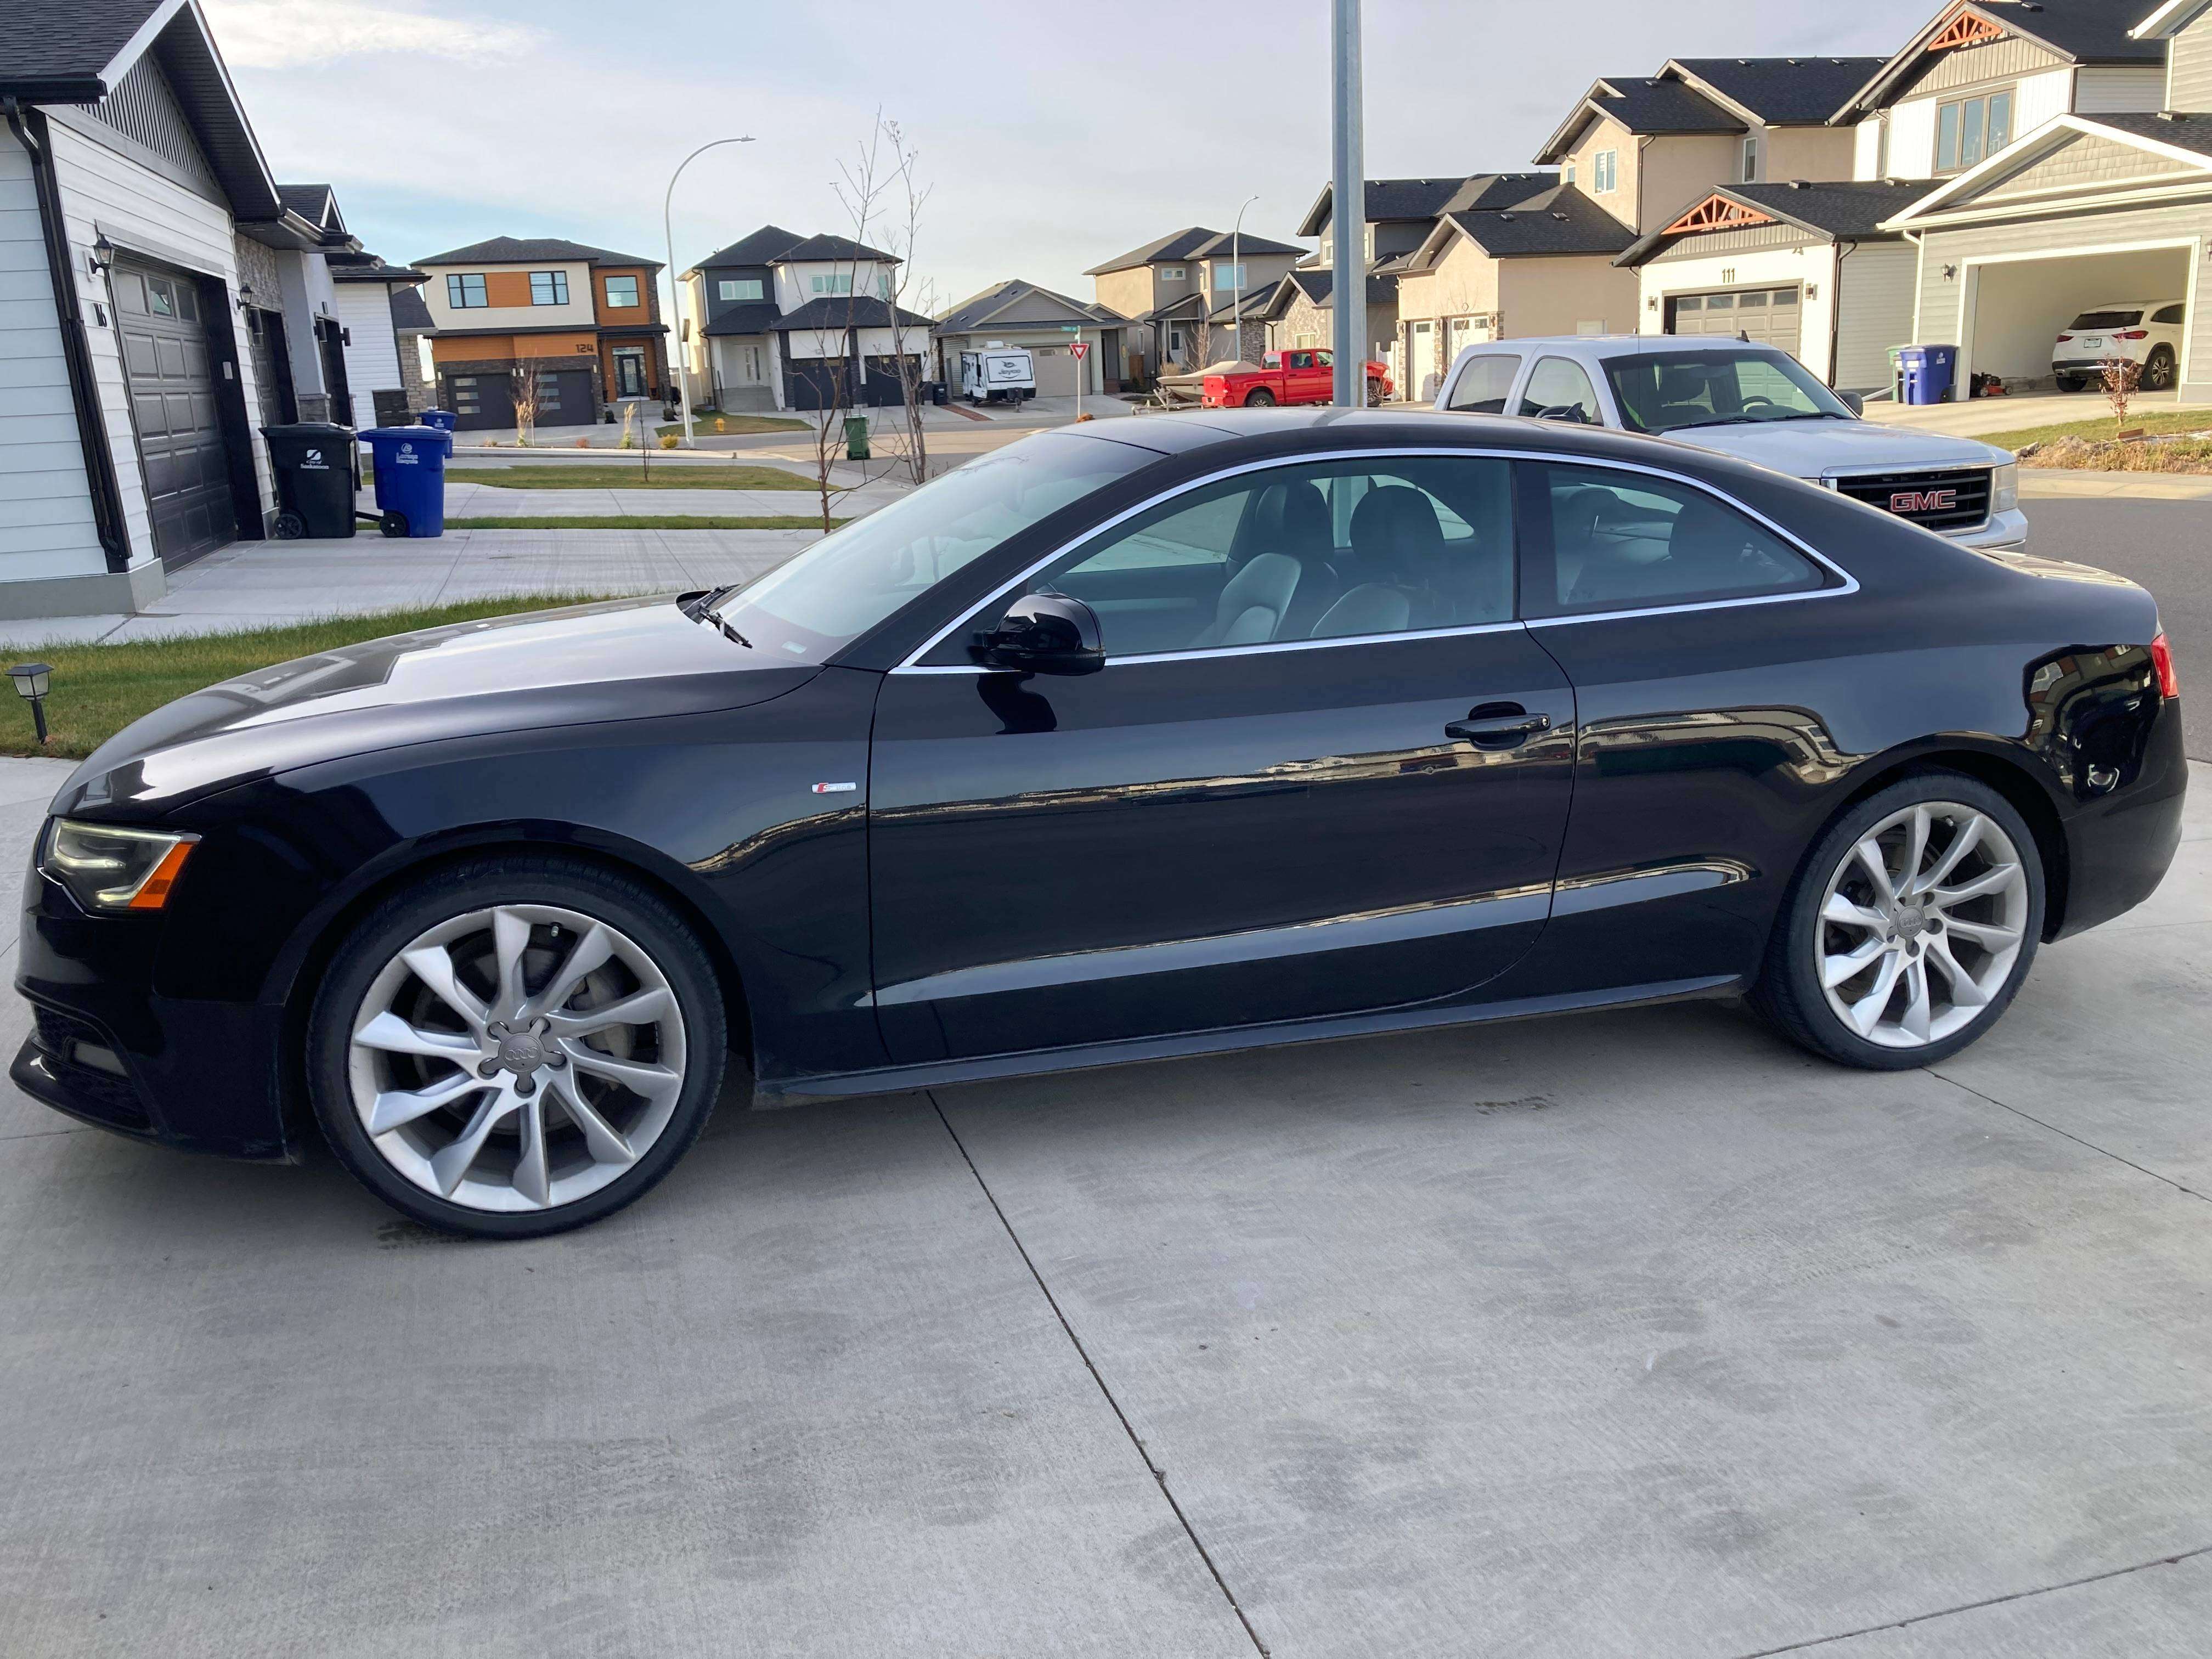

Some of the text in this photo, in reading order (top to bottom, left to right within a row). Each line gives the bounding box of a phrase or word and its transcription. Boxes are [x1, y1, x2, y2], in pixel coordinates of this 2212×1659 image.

[1722, 268, 1735, 283] 111
[575, 343, 594, 353] 124
[1891, 489, 1956, 512] GMC
